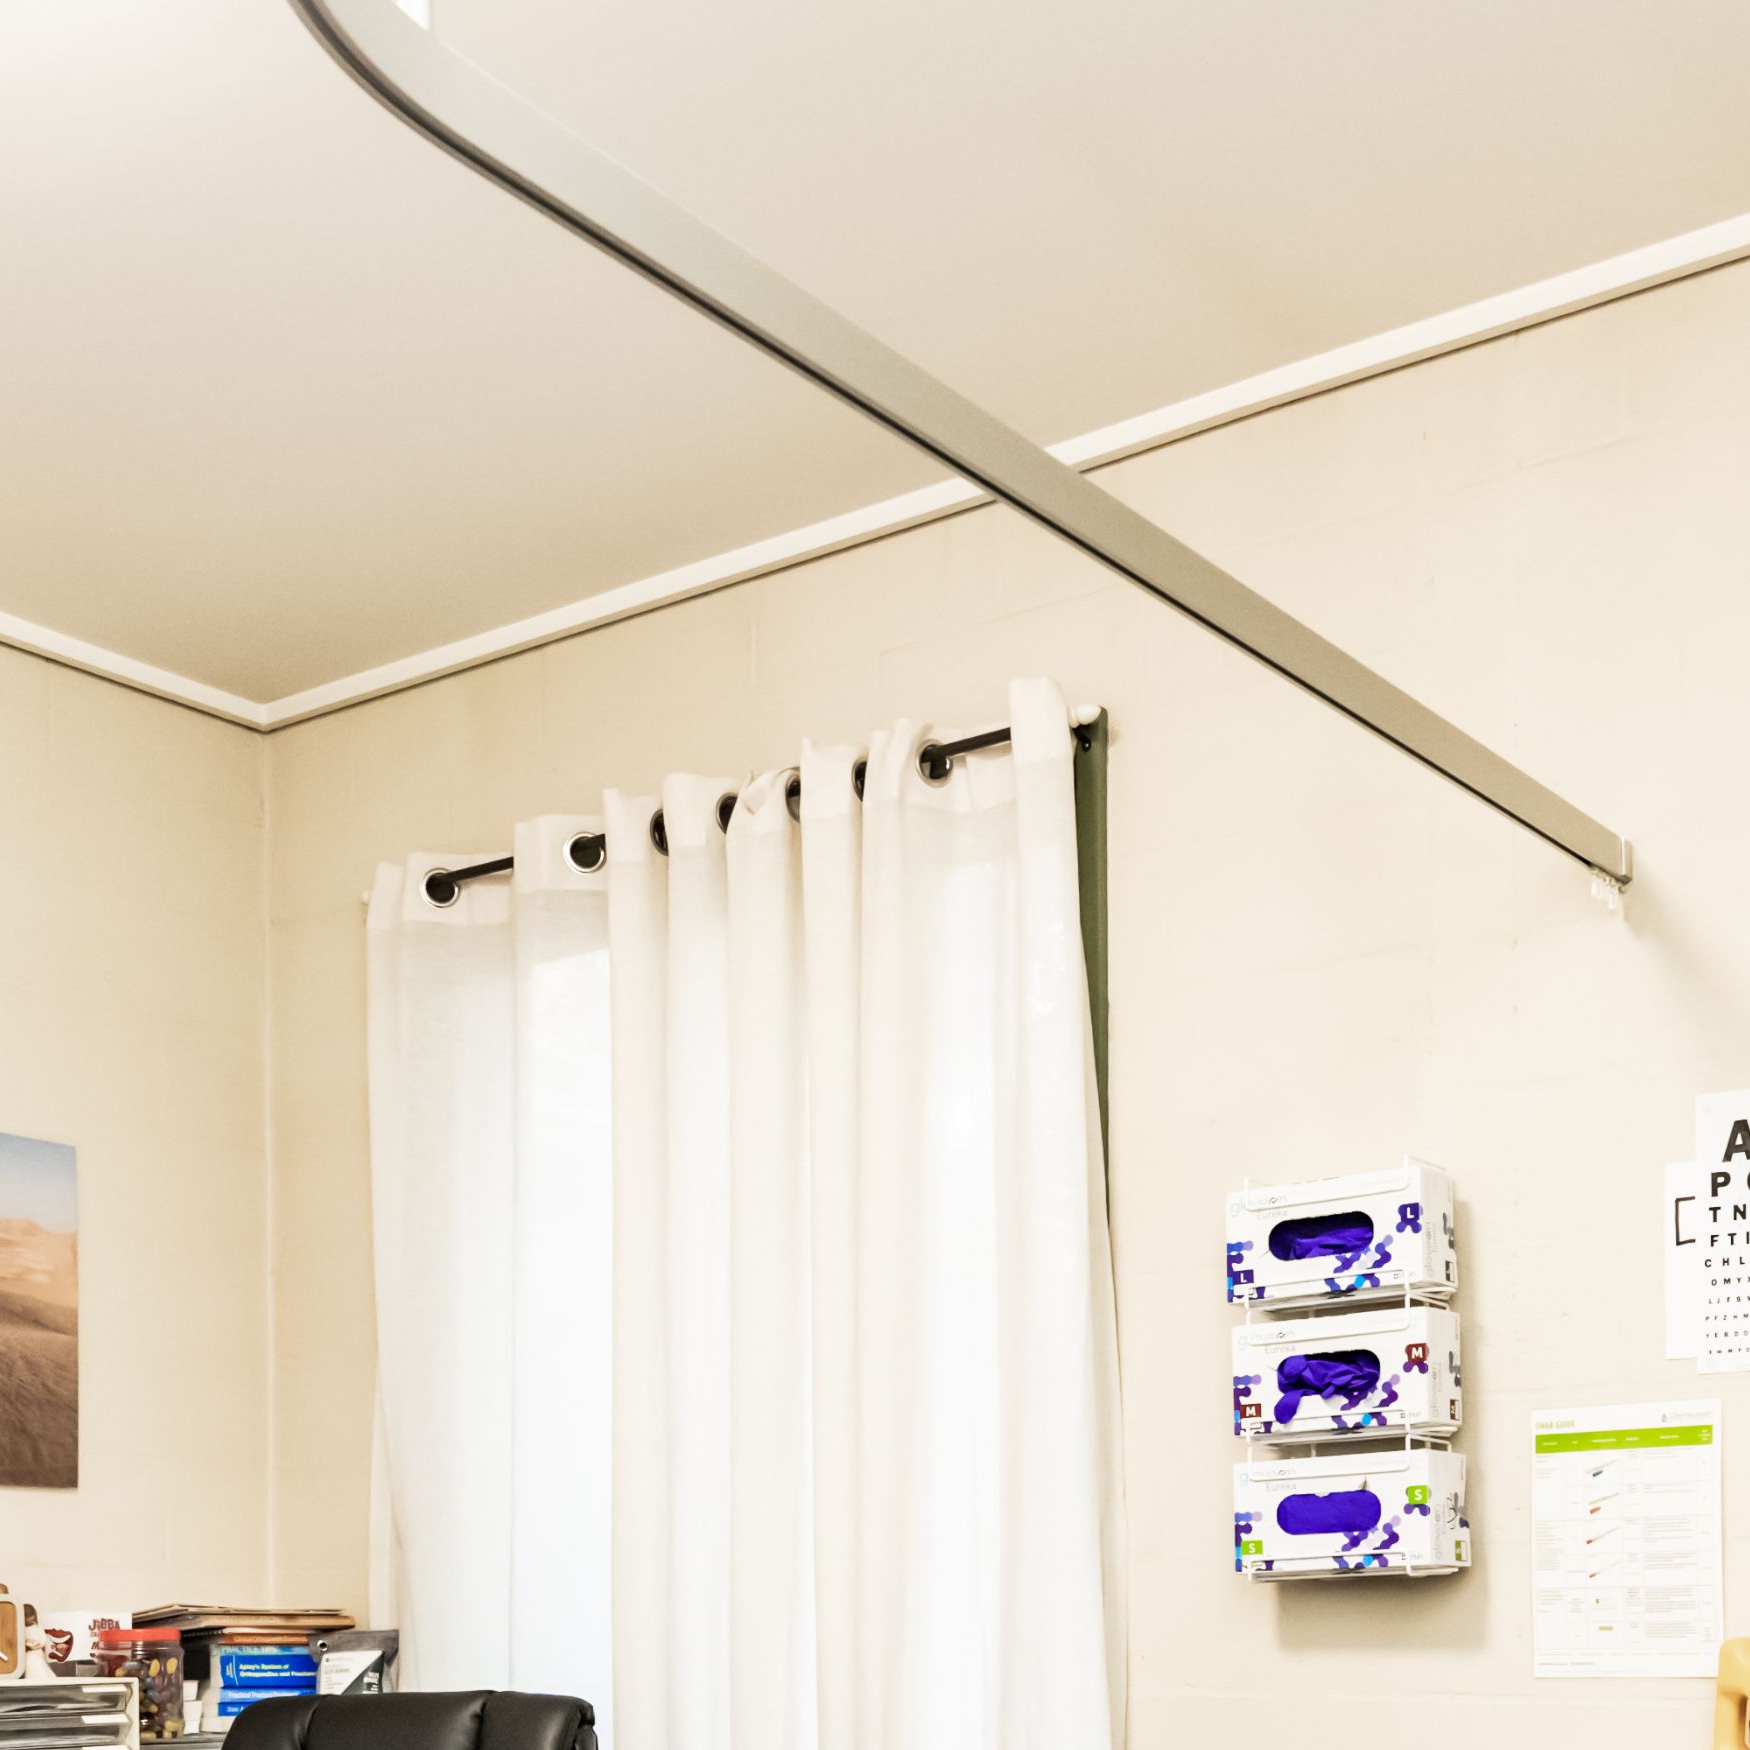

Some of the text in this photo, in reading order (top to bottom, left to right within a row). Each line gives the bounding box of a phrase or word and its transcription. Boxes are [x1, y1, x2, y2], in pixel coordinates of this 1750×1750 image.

[1406, 1207, 1415, 1219] L
[1240, 1272, 1248, 1283] L
[1411, 1348, 1424, 1359] M
[1245, 1406, 1257, 1417] M
[1414, 1488, 1423, 1501] S
[1249, 1543, 1256, 1553] S
